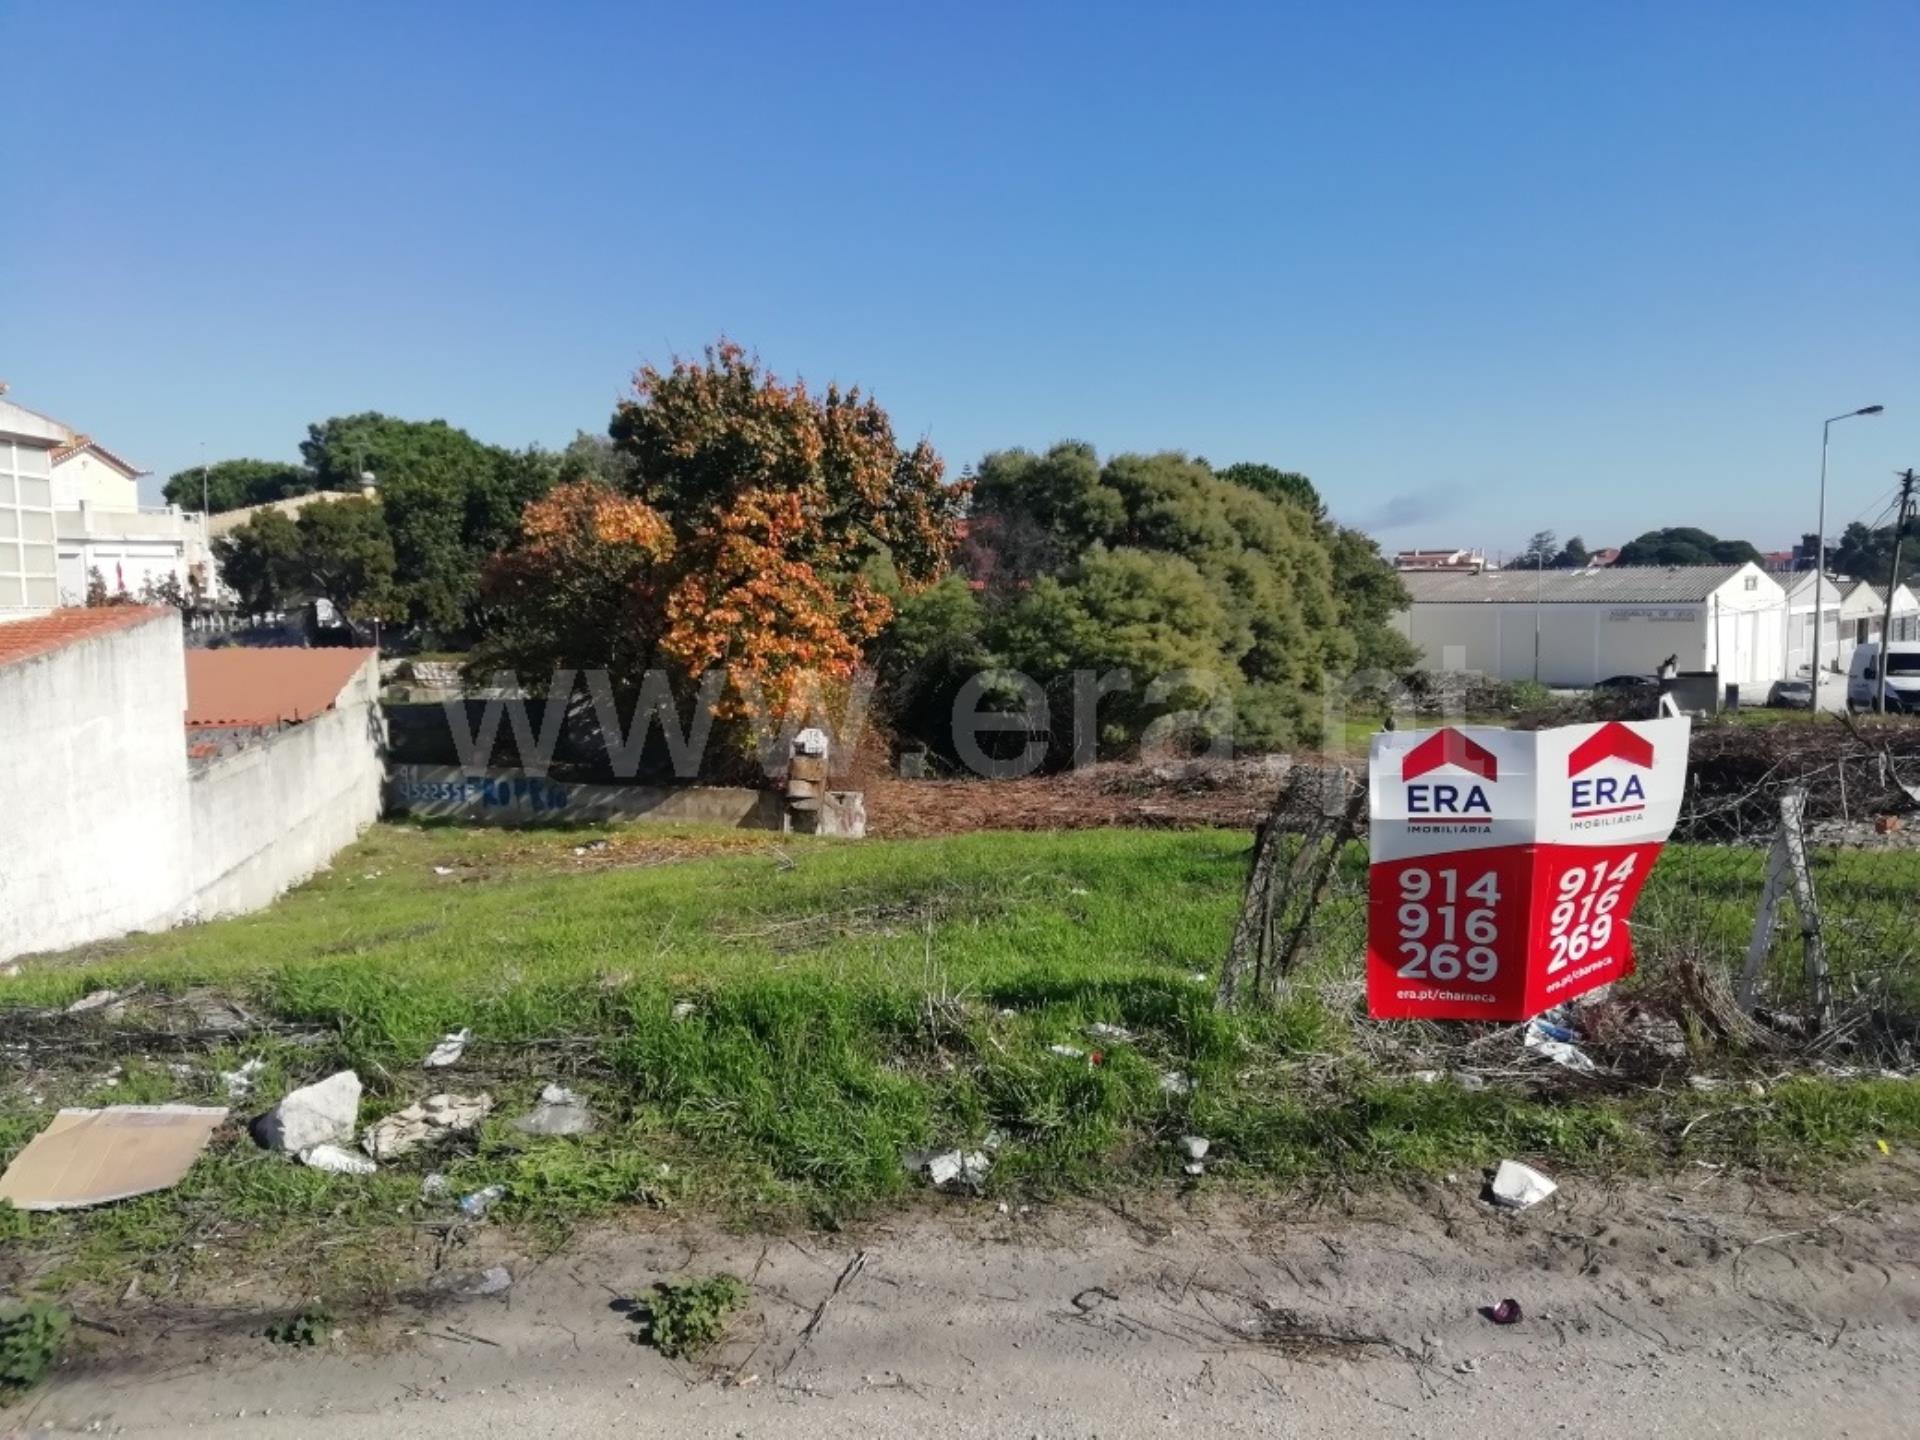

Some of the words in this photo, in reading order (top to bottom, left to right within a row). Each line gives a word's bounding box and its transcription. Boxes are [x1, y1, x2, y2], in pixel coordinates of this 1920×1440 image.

[1407, 785, 1491, 813] ERA
[1572, 774, 1645, 808] ERA
[1398, 868, 1501, 907] 914
[1557, 852, 1638, 902] 914
[1398, 902, 1498, 945] 916
[1550, 884, 1624, 937] 916
[1396, 941, 1498, 983] 269
[1546, 913, 1613, 975] 269
[1396, 989, 1496, 1003] era.pt/charneca
